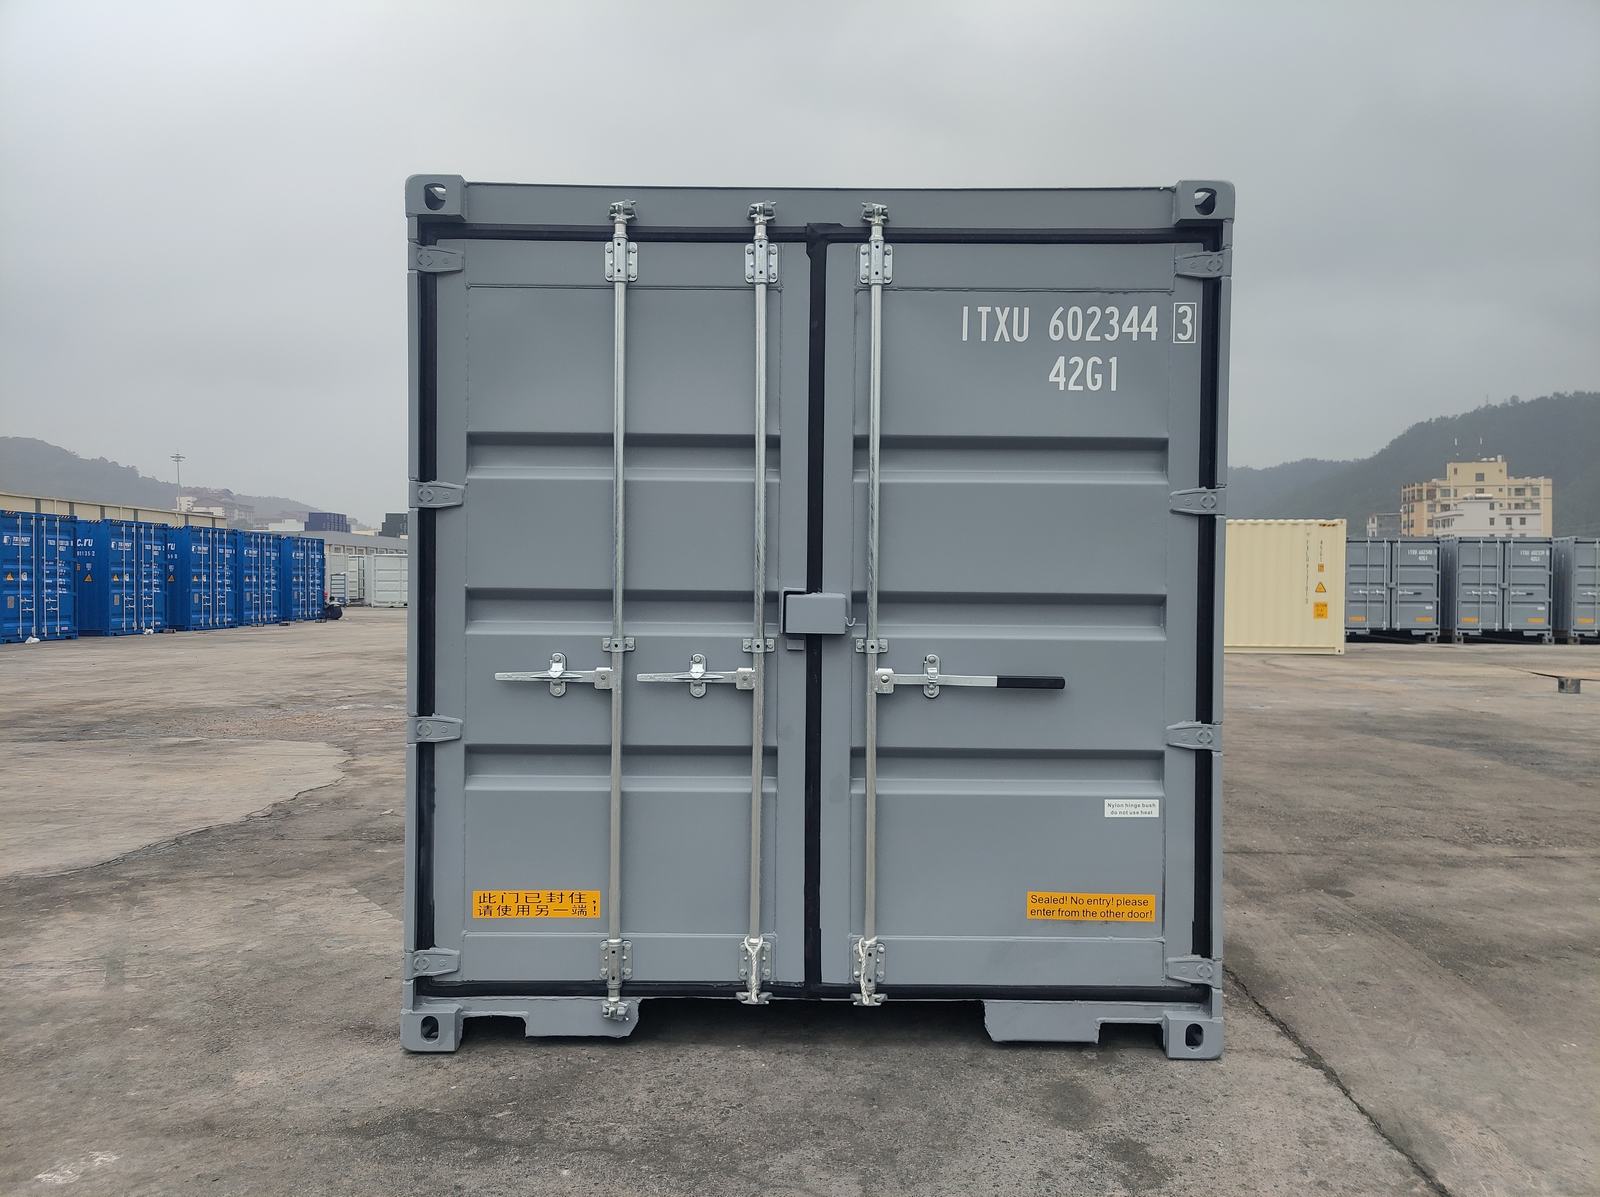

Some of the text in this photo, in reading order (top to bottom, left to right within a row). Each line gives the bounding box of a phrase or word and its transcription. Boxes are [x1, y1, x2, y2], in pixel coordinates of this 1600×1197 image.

[962, 304, 1194, 342] ITXU 602344 3
[1049, 355, 1117, 391] 42G1
[1030, 895, 1149, 908] Sealed! No entry! please
[1030, 908, 1152, 919] enter from the other door!
